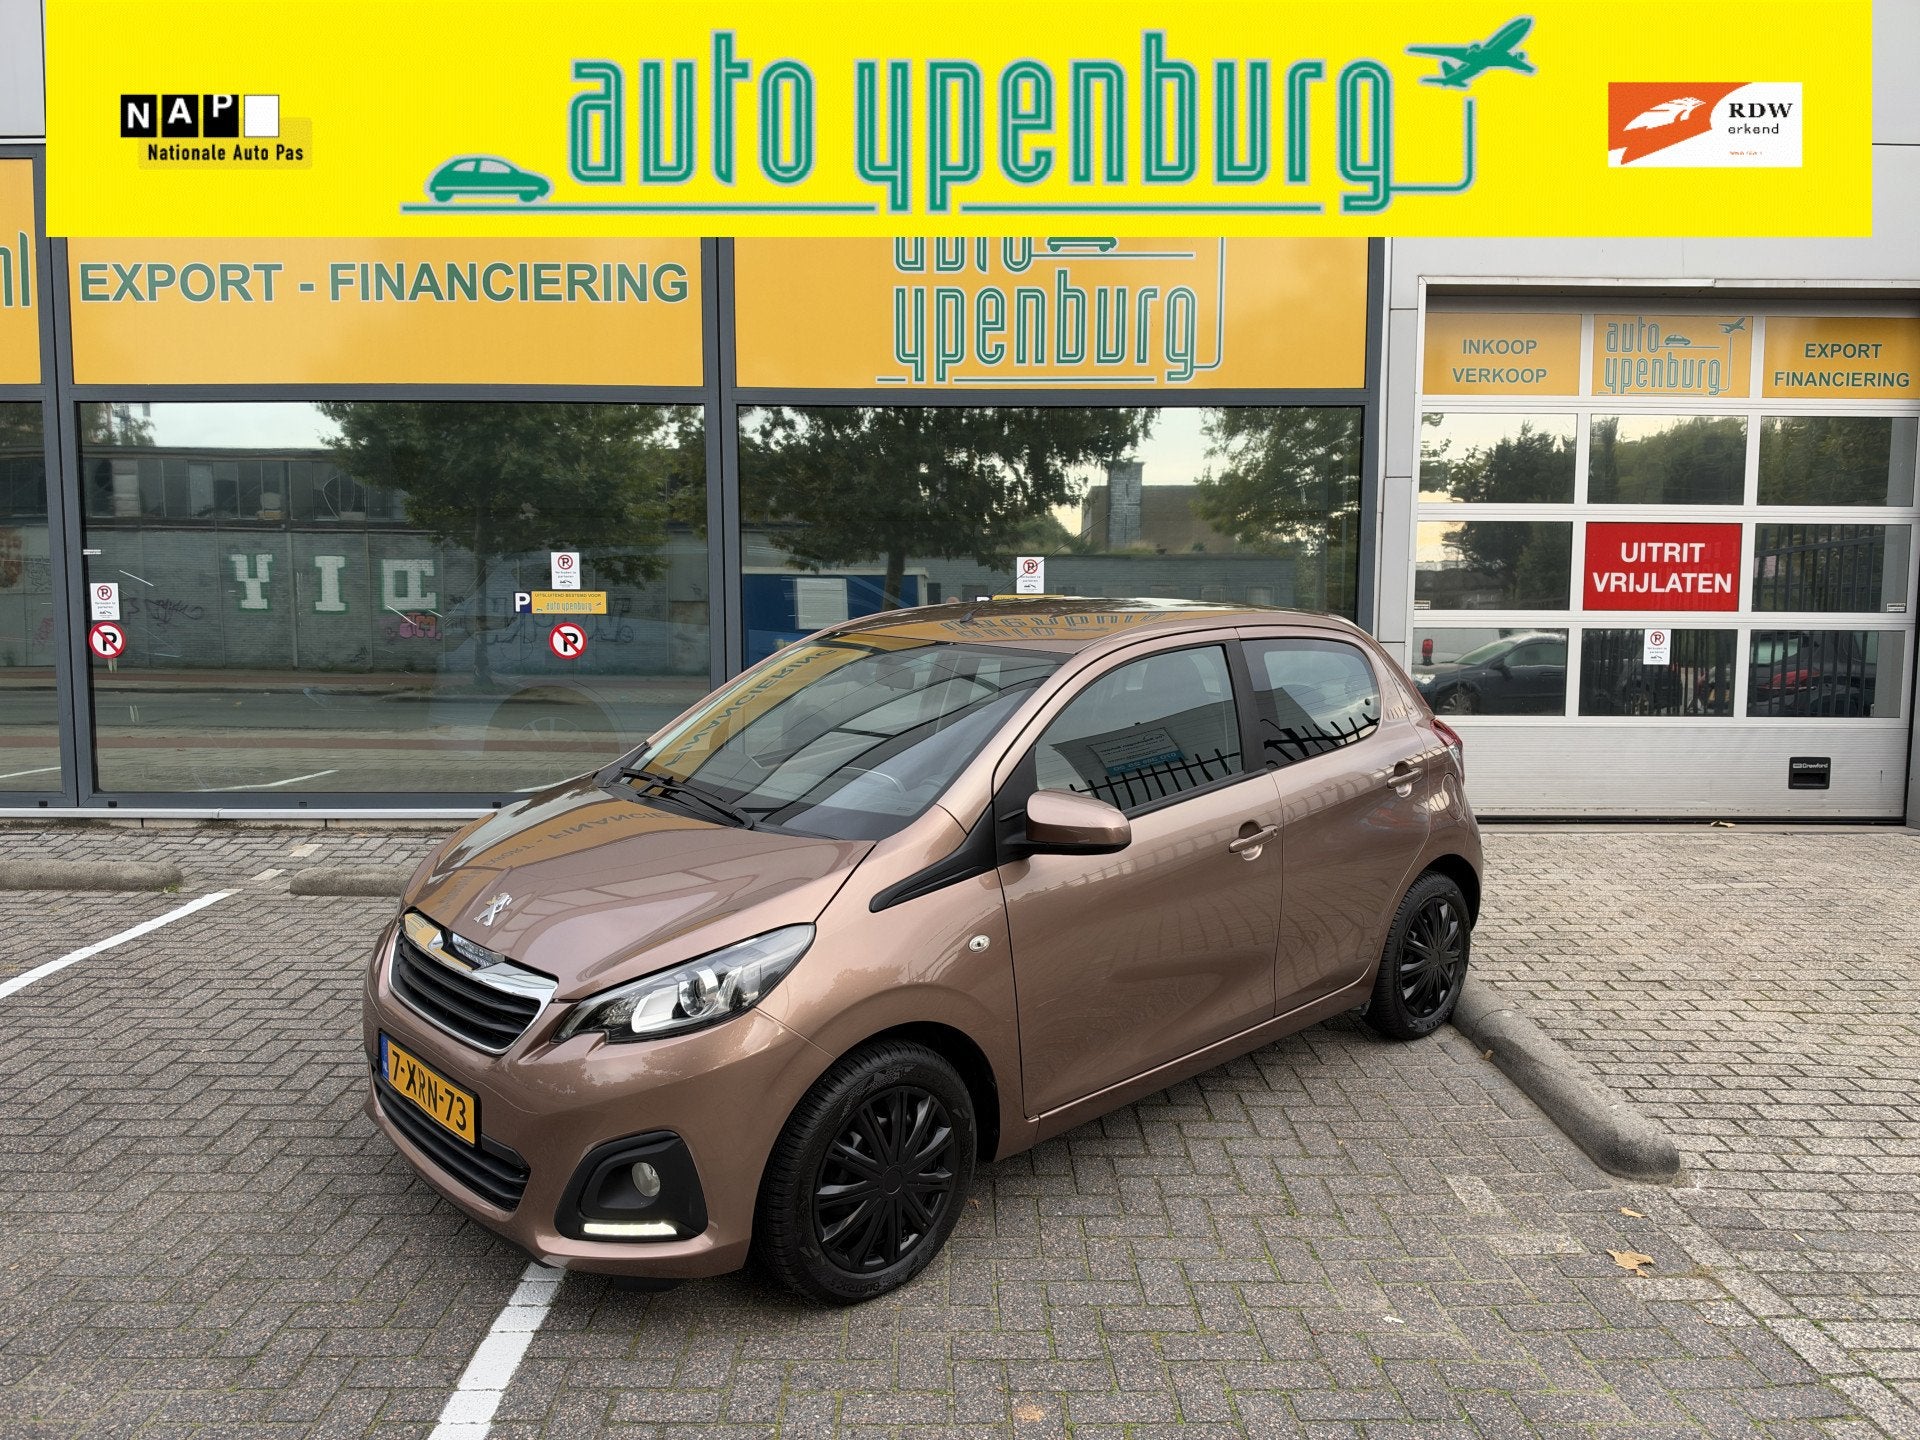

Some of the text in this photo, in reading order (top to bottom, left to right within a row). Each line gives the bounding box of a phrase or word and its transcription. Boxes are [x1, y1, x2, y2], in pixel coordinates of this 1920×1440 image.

[79, 262, 284, 302] EXPORT
[329, 261, 689, 303] FINANCIERING
[893, 268, 1198, 384] ypenburg
[1605, 316, 1660, 353] auto
[1462, 339, 1537, 355] INKOOP
[1804, 342, 1883, 359] EXPORT
[1452, 367, 1547, 384] VERKOOP
[1603, 352, 1721, 396] ypenburg
[1774, 371, 1910, 388] FINANCIERING
[1620, 542, 1705, 563] UITRIT
[1593, 572, 1732, 594] VRIJLATEN
[515, 593, 531, 612] P
[392, 1050, 467, 1131] 7-XRN-73
